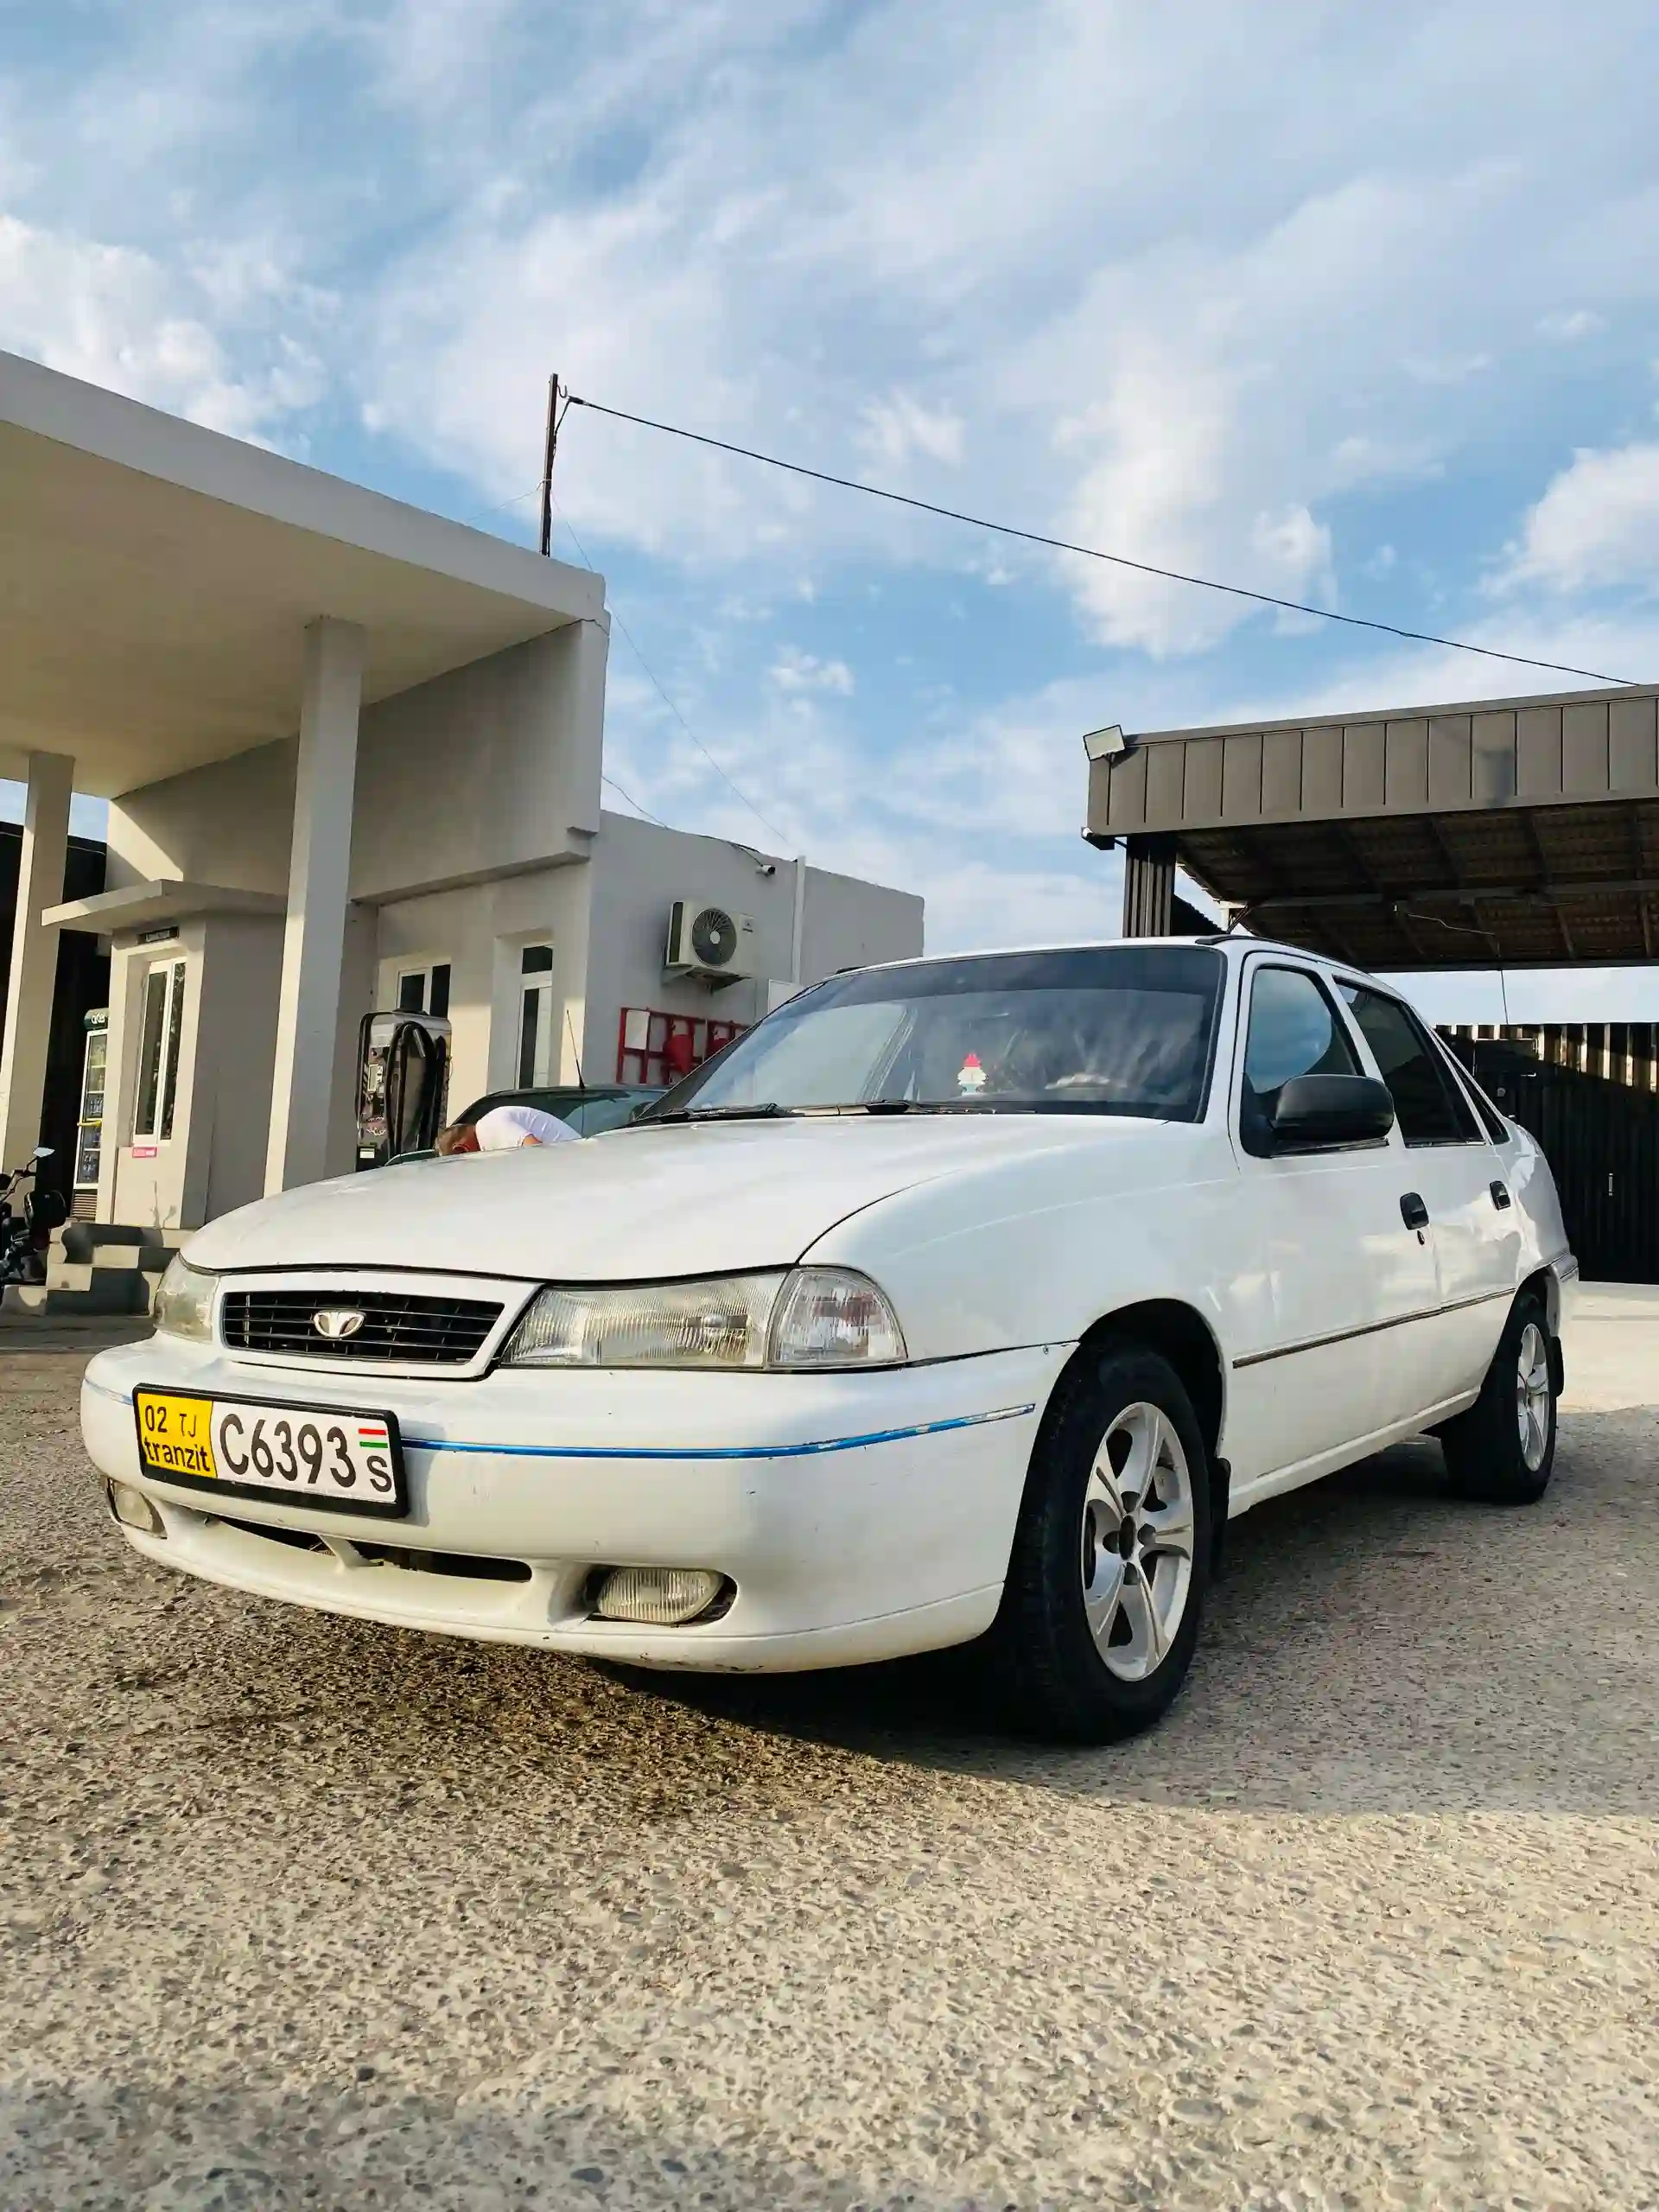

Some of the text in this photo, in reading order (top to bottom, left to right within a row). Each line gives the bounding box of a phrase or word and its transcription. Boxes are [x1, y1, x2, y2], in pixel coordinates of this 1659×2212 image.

[144, 1404, 196, 1438] 02 TJ
[143, 1436, 211, 1471] tranzit
[219, 1414, 357, 1488] C6393
